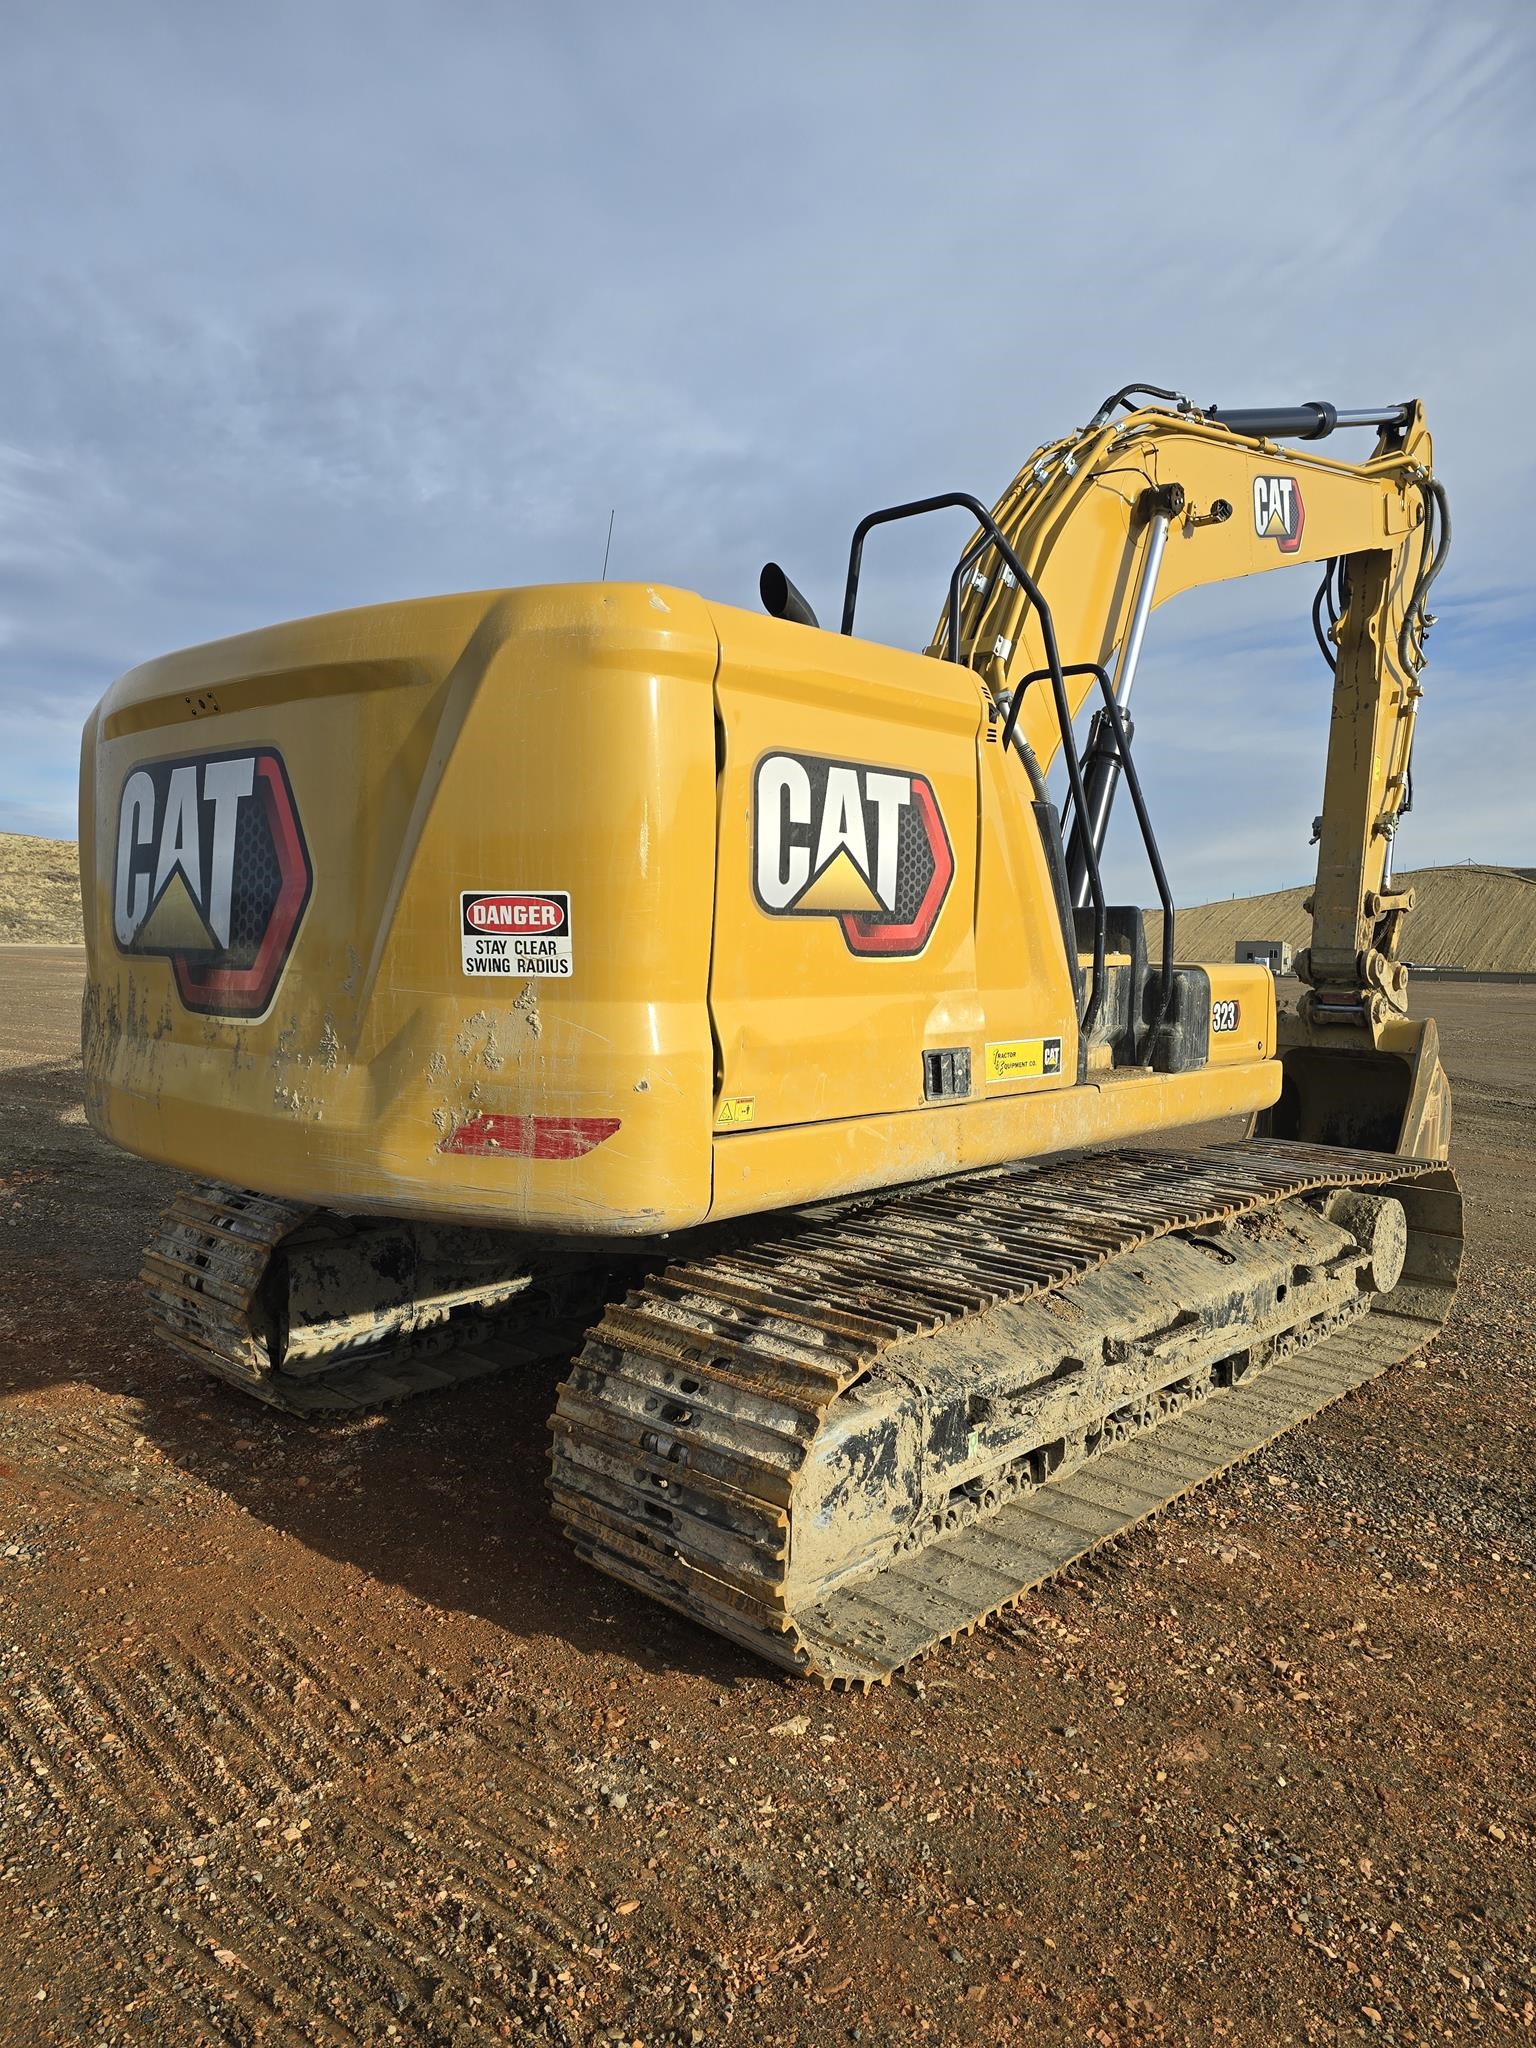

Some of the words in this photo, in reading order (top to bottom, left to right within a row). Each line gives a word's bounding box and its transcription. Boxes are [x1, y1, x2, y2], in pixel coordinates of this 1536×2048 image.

[1254, 477, 1292, 535] CAT
[758, 756, 910, 912] CAT
[116, 758, 255, 949] CAT
[473, 905, 556, 925] DANGER
[475, 940, 507, 954] STAY
[515, 940, 557, 955] CLEAR
[466, 958, 510, 972] SWING
[518, 959, 568, 973] RADIUS
[1213, 1001, 1235, 1031] 323
[994, 1049, 1016, 1065] TRACTOR
[1045, 1048, 1059, 1065] CAT
